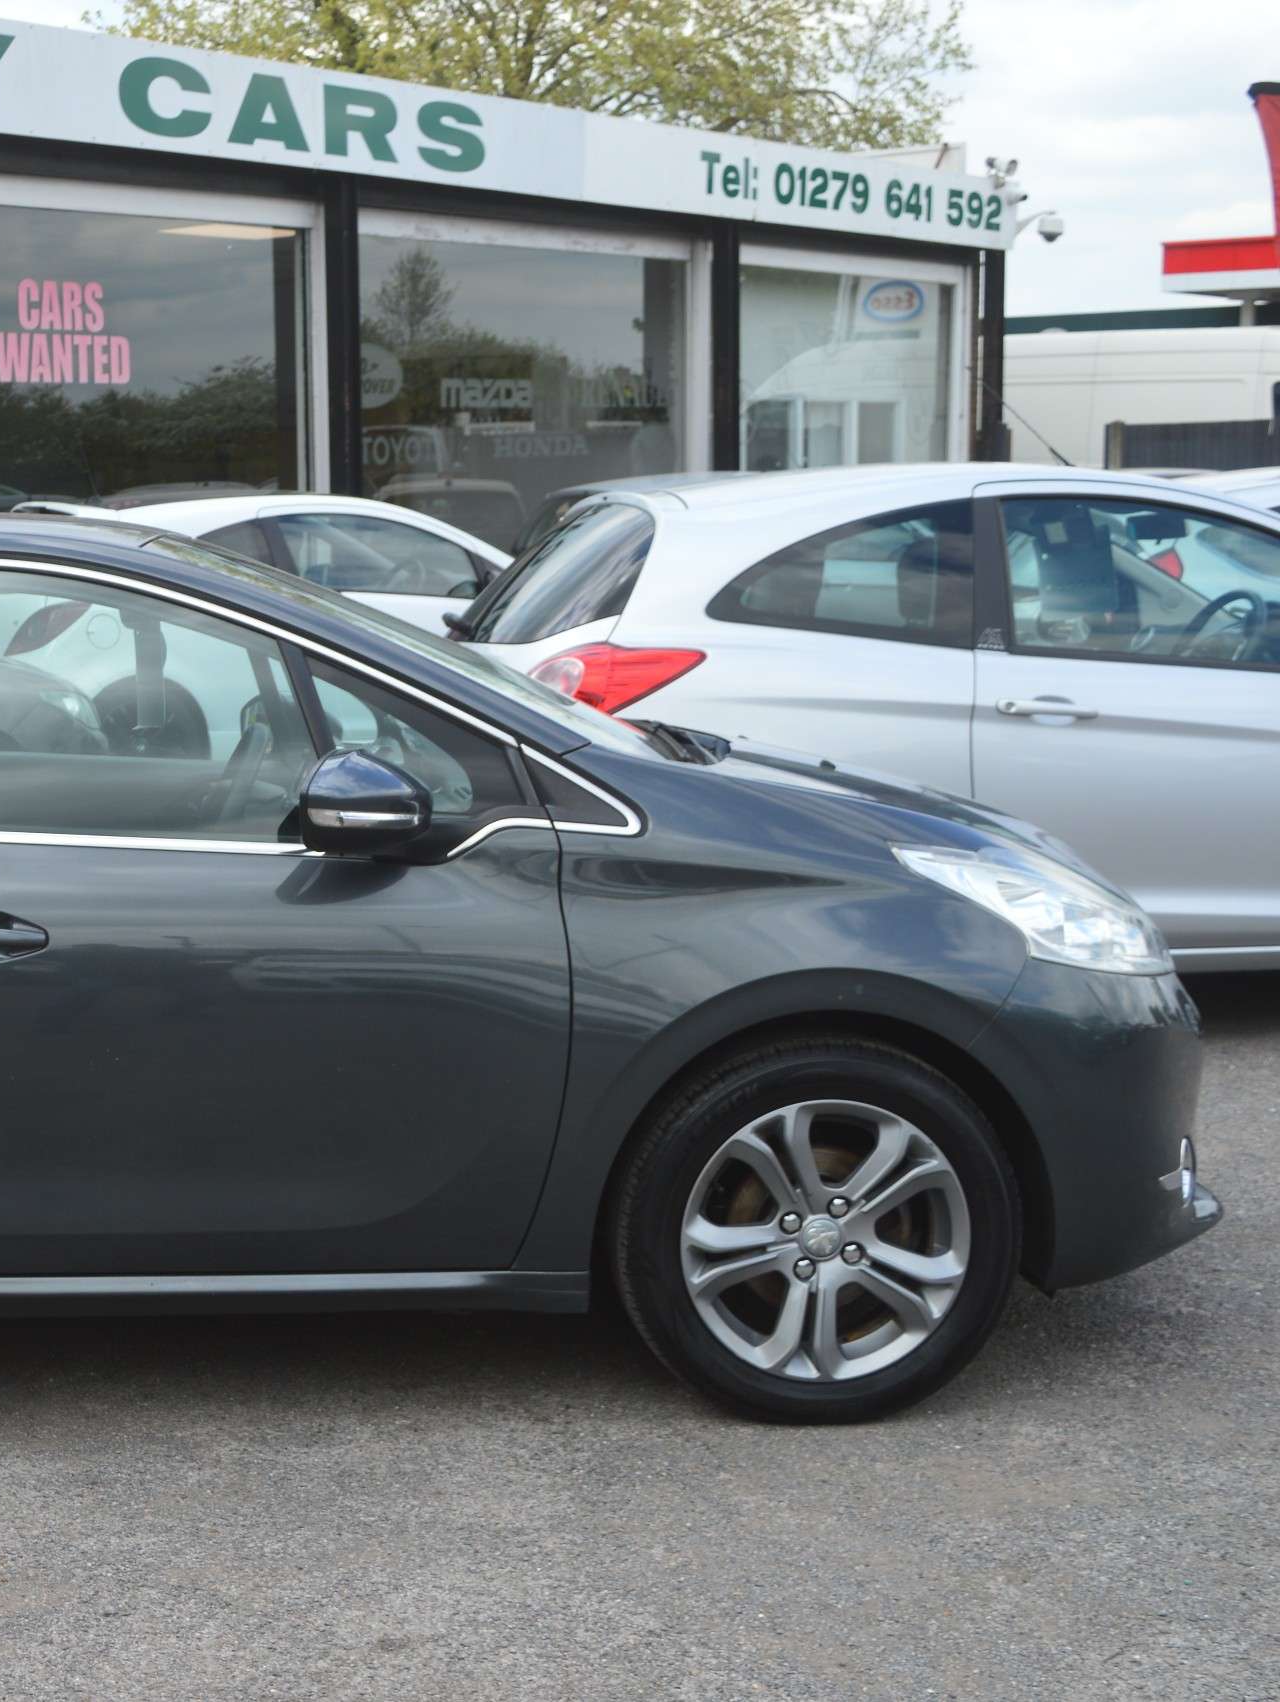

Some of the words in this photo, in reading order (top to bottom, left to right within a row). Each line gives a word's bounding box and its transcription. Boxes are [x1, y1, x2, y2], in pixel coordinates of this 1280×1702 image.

[118, 56, 485, 173] CARS
[701, 150, 758, 200] Tel:
[775, 162, 869, 214] 01279
[885, 178, 932, 223] 641
[946, 188, 1003, 232] 592
[18, 277, 105, 333] CARS
